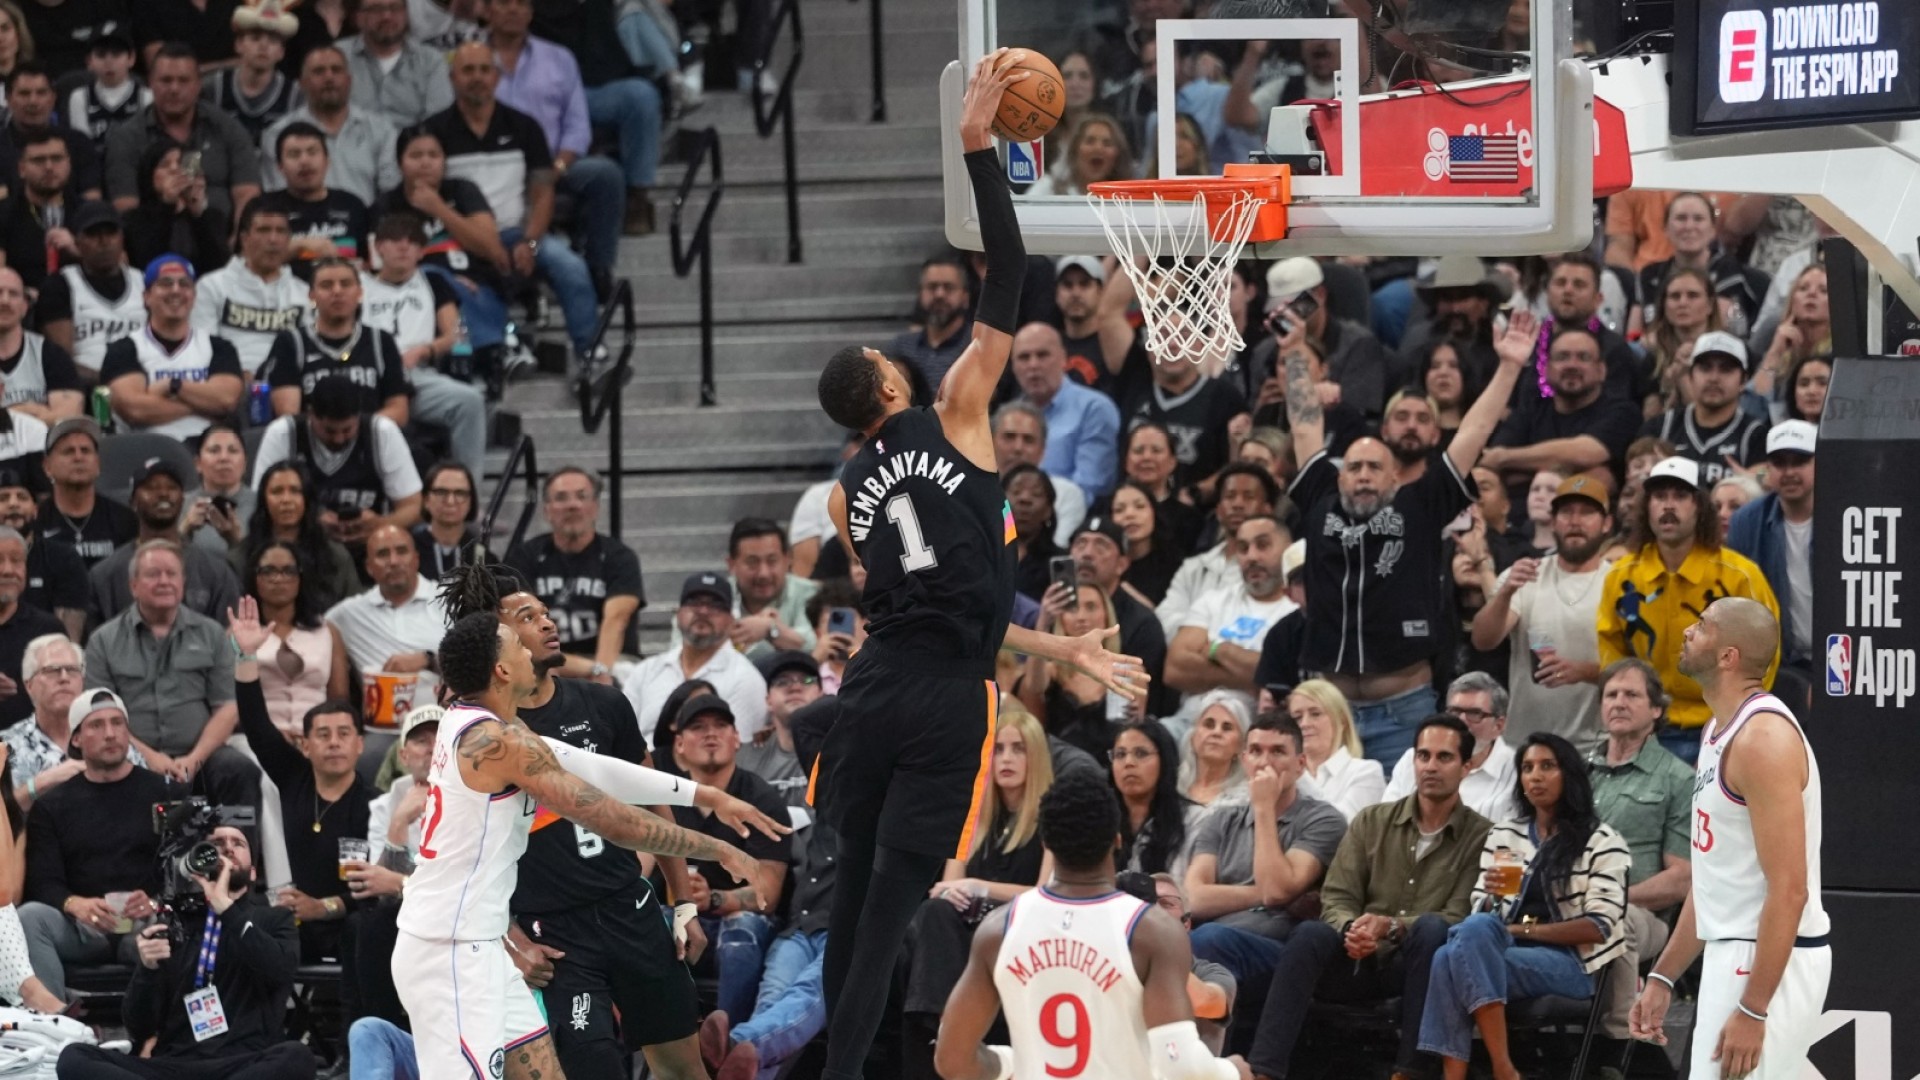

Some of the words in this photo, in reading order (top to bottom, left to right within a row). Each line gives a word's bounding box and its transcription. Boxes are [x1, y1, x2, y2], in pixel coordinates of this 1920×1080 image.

[1772, 2, 1879, 50] DOWNLOAD
[1772, 56, 1806, 100] THE
[1809, 52, 1858, 97] ESPN
[1860, 49, 1899, 94] APP
[1012, 161, 1031, 177] NBA
[73, 319, 142, 342] SPUR
[227, 304, 299, 332] SPURS
[850, 450, 966, 542] WEMBANYAMA
[885, 493, 938, 574] 1
[1842, 506, 1902, 565] GET
[1841, 571, 1902, 628] THE
[1855, 636, 1916, 708] App
[1006, 939, 1122, 993] MATHURIN
[1039, 992, 1092, 1079] 9
